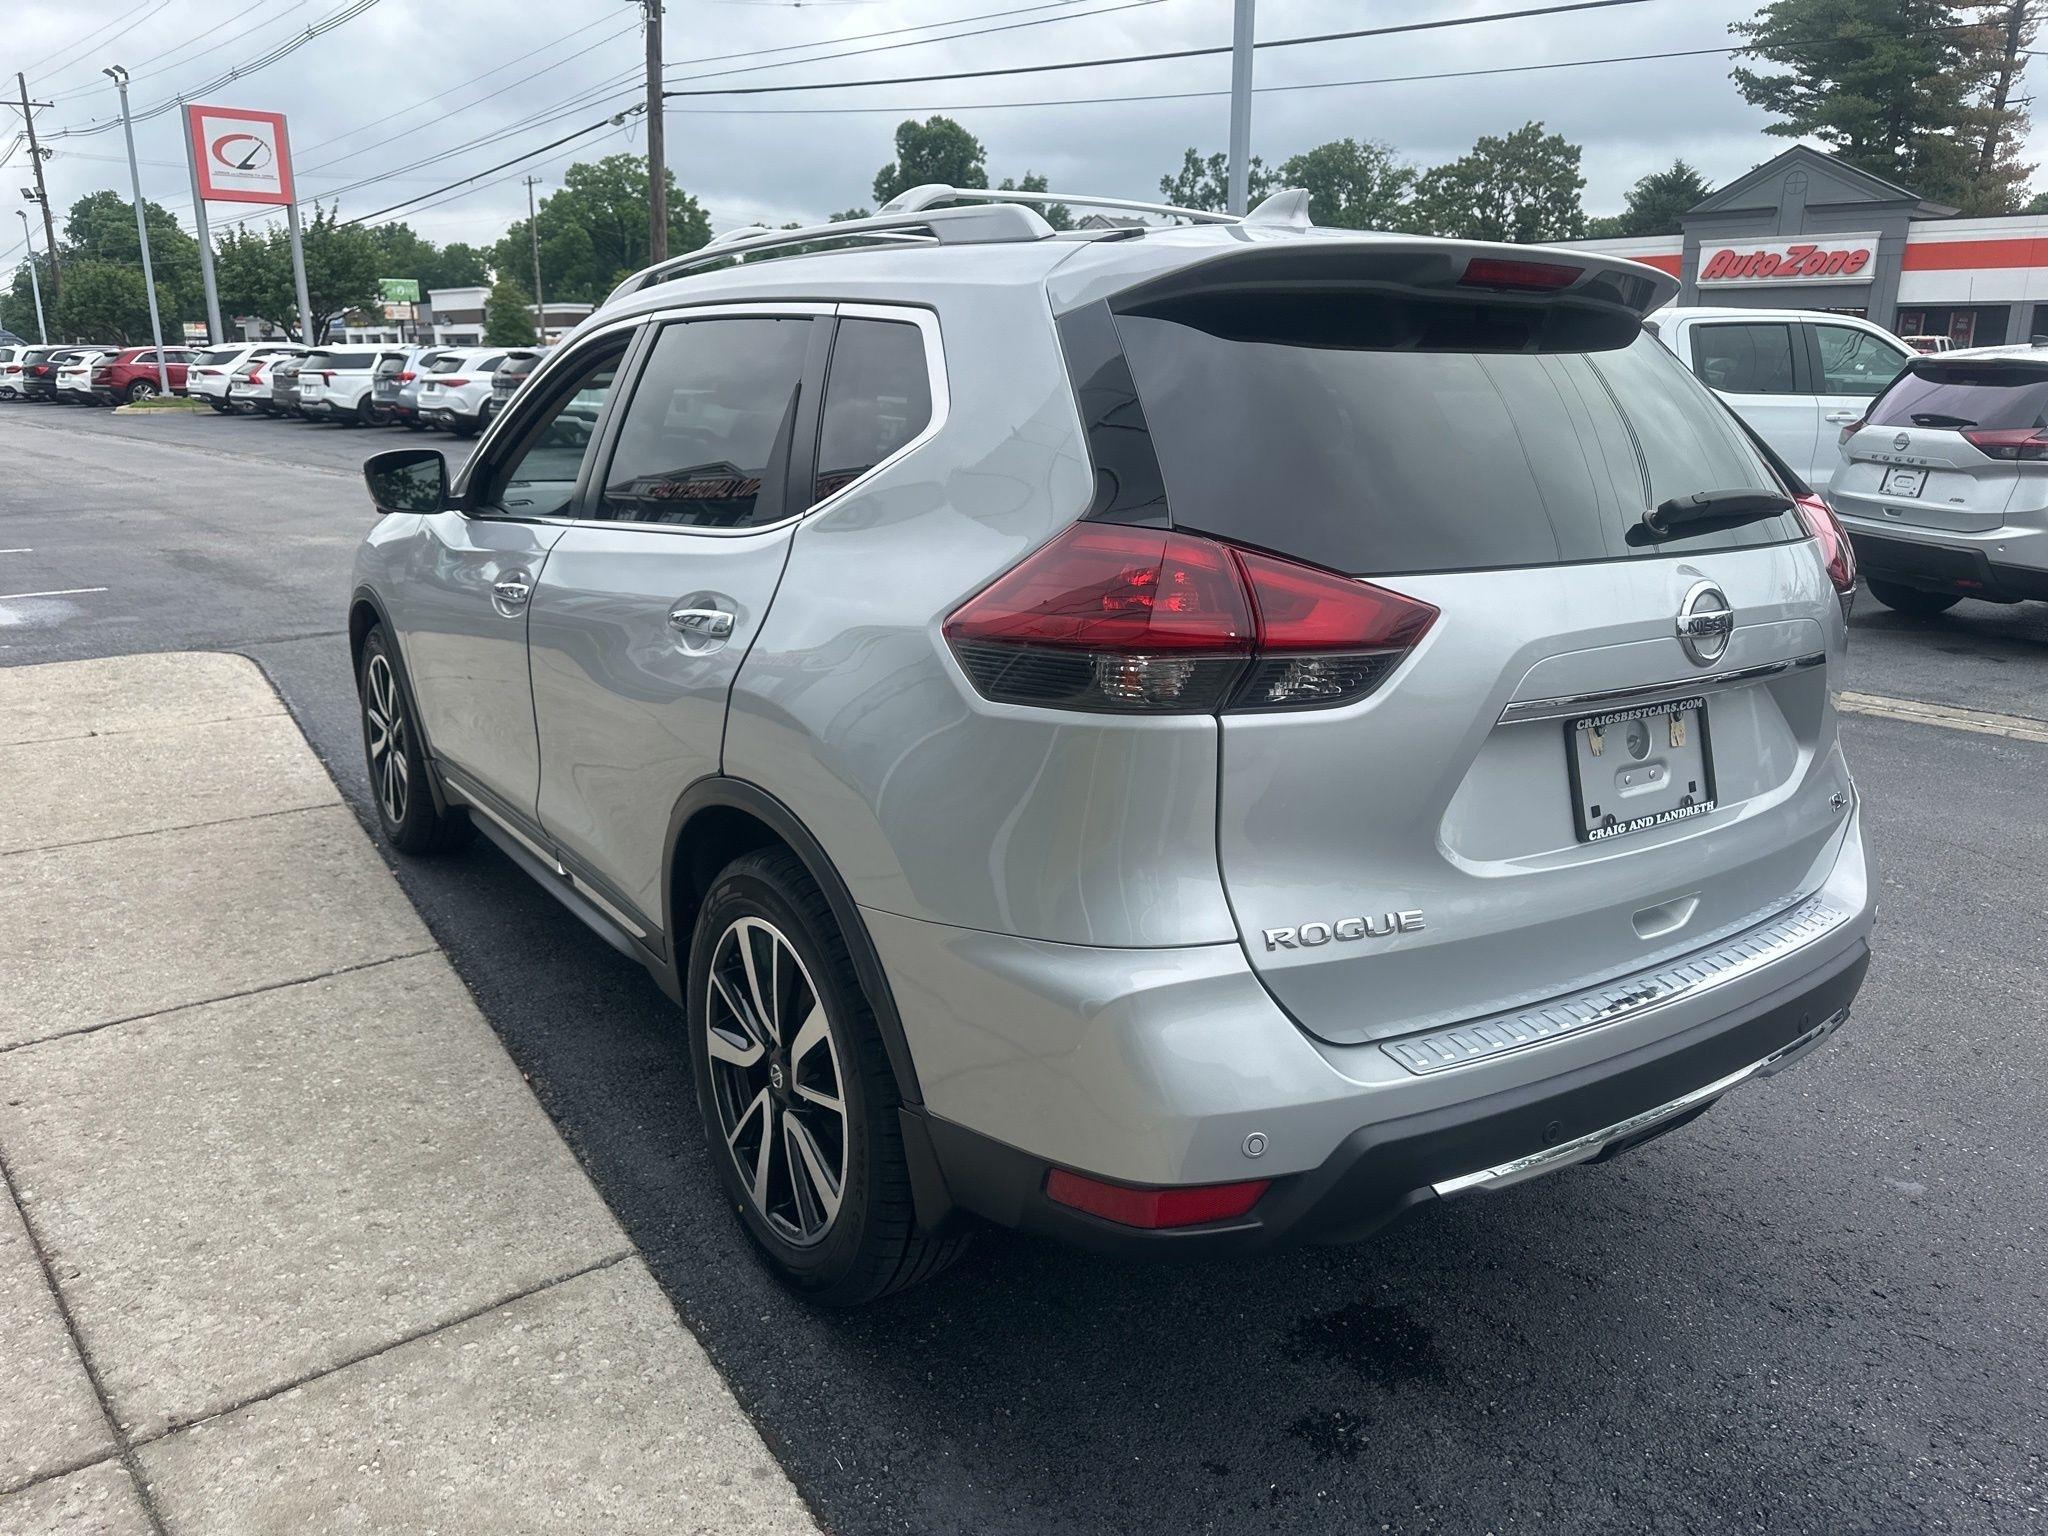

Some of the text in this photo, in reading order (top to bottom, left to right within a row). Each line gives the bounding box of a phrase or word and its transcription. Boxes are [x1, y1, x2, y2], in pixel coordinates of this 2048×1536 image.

[1701, 245, 1871, 279] AutoZone
[1576, 699, 1703, 730] CRAIGSBESTCARS.COM
[1588, 800, 1715, 841] CRAIG AND LANDRETH
[1262, 909, 1426, 951] ROGUE
